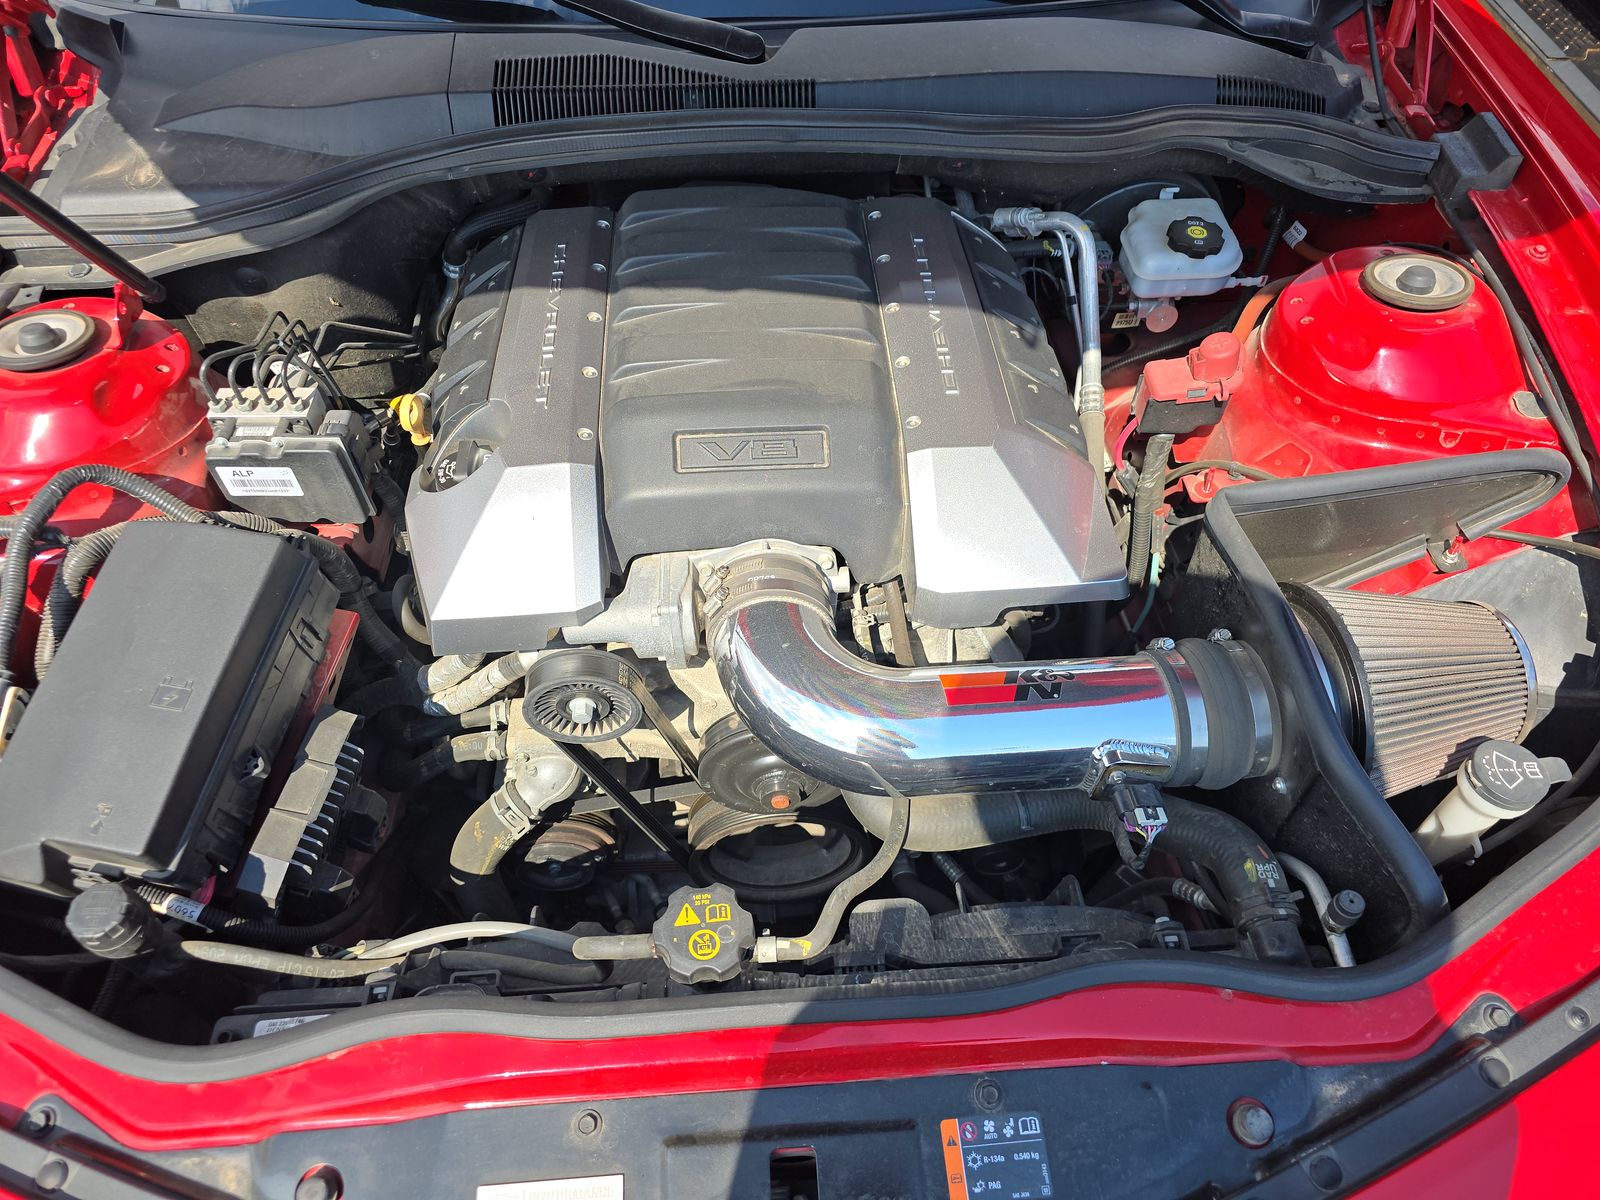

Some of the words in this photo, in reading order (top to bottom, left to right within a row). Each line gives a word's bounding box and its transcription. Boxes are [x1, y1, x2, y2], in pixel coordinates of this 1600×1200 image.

[910, 233, 960, 394] CHEVROLET
[535, 244, 566, 410] CHEVROLET
[697, 438, 798, 461] V8
[232, 469, 255, 478] ALP
[1003, 668, 1076, 702] K&N
[1255, 861, 1277, 871] UPR
[1257, 870, 1280, 880] RAD
[984, 1132, 998, 1140] AUTO
[983, 1155, 1005, 1163] R-134a
[1031, 1151, 1040, 1160] kg
[988, 1181, 1002, 1190] PAG
